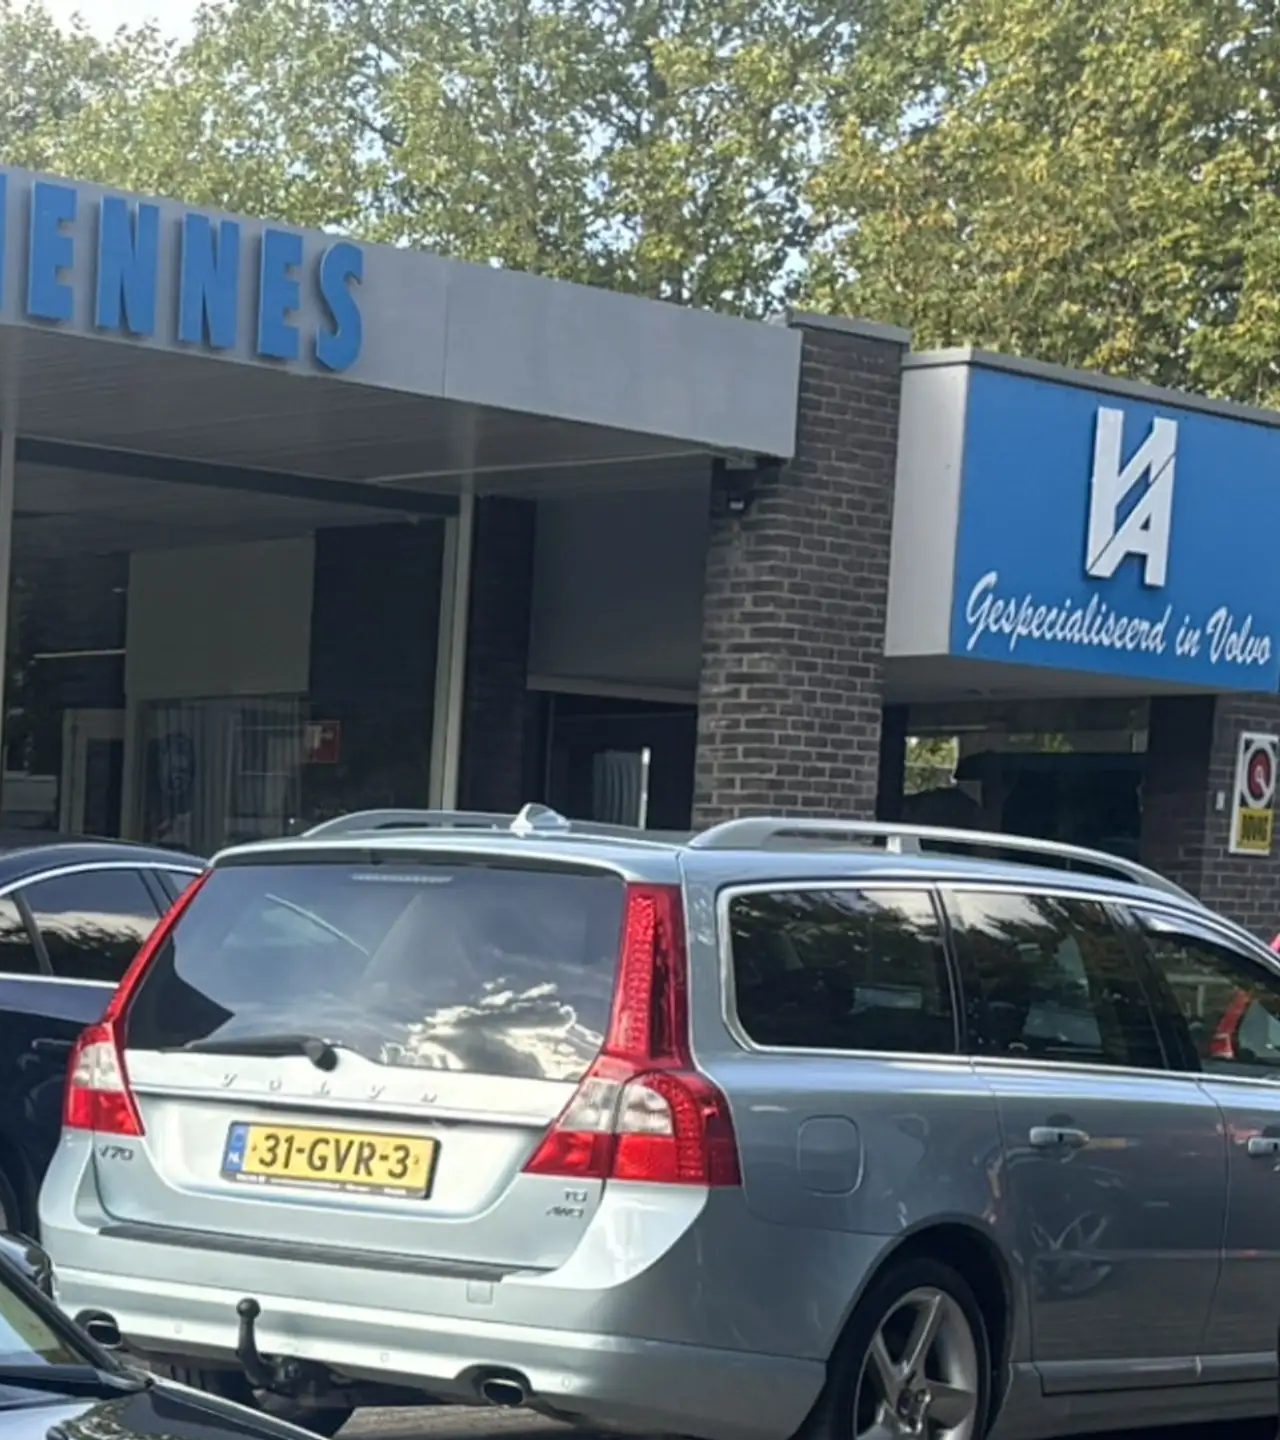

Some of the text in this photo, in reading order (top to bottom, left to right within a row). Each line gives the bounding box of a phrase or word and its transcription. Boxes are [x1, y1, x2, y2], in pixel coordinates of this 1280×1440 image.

[965, 570, 1273, 666] Gespecialiseerd in Volvo
[98, 1145, 134, 1161] V70
[258, 1132, 411, 1180] 31-GVR-3
